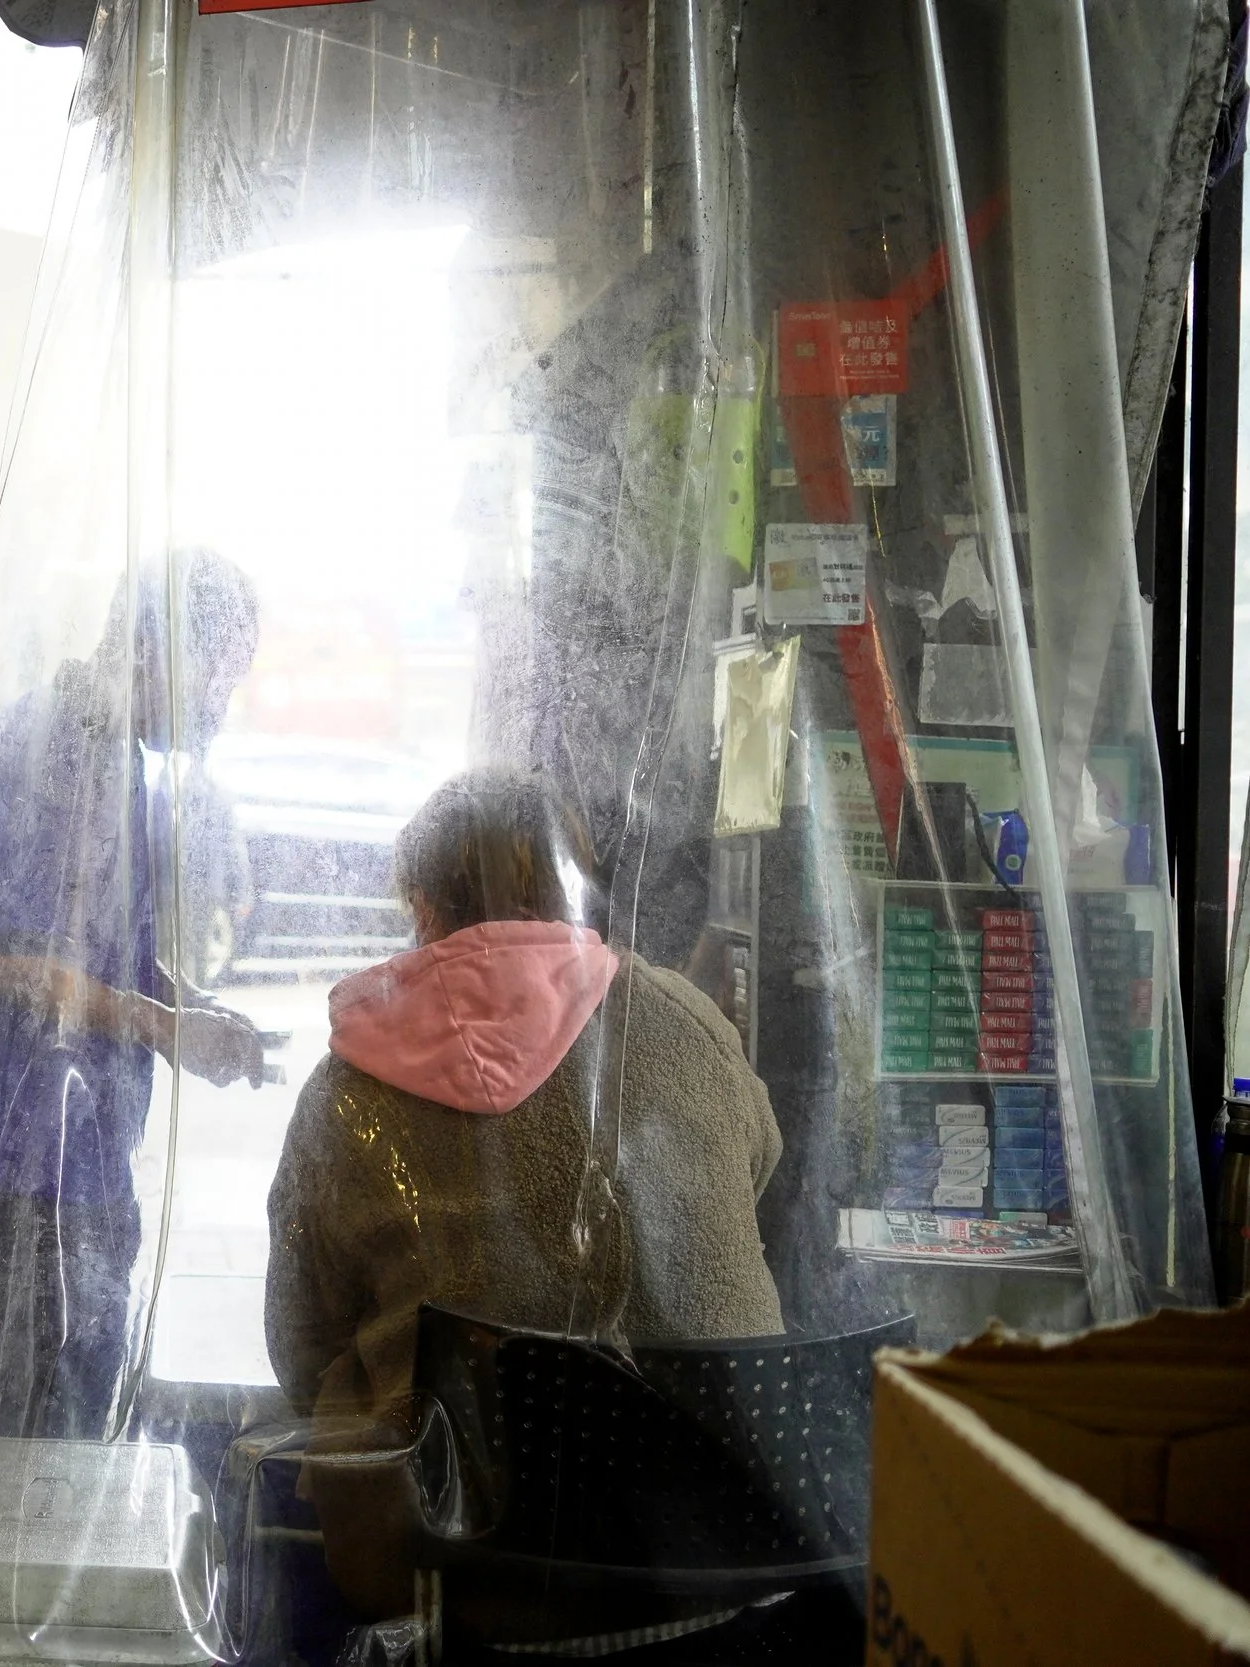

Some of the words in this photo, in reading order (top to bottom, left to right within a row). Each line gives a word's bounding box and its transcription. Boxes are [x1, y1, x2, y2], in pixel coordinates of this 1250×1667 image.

[990, 915, 1004, 927] PALL
[1005, 915, 1019, 927] MALL
[991, 935, 1004, 948] PALL
[1005, 935, 1020, 948] MALL
[989, 955, 1003, 968] PALL
[1004, 955, 1018, 968] MALL
[987, 1016, 1001, 1029] PALL
[1002, 1016, 1016, 1029] MALL
[986, 1037, 1000, 1049] PALL
[1001, 1037, 1015, 1049] MALL
[958, 1137, 986, 1145] MEVIUS
[941, 1168, 970, 1176] MEVIUS
